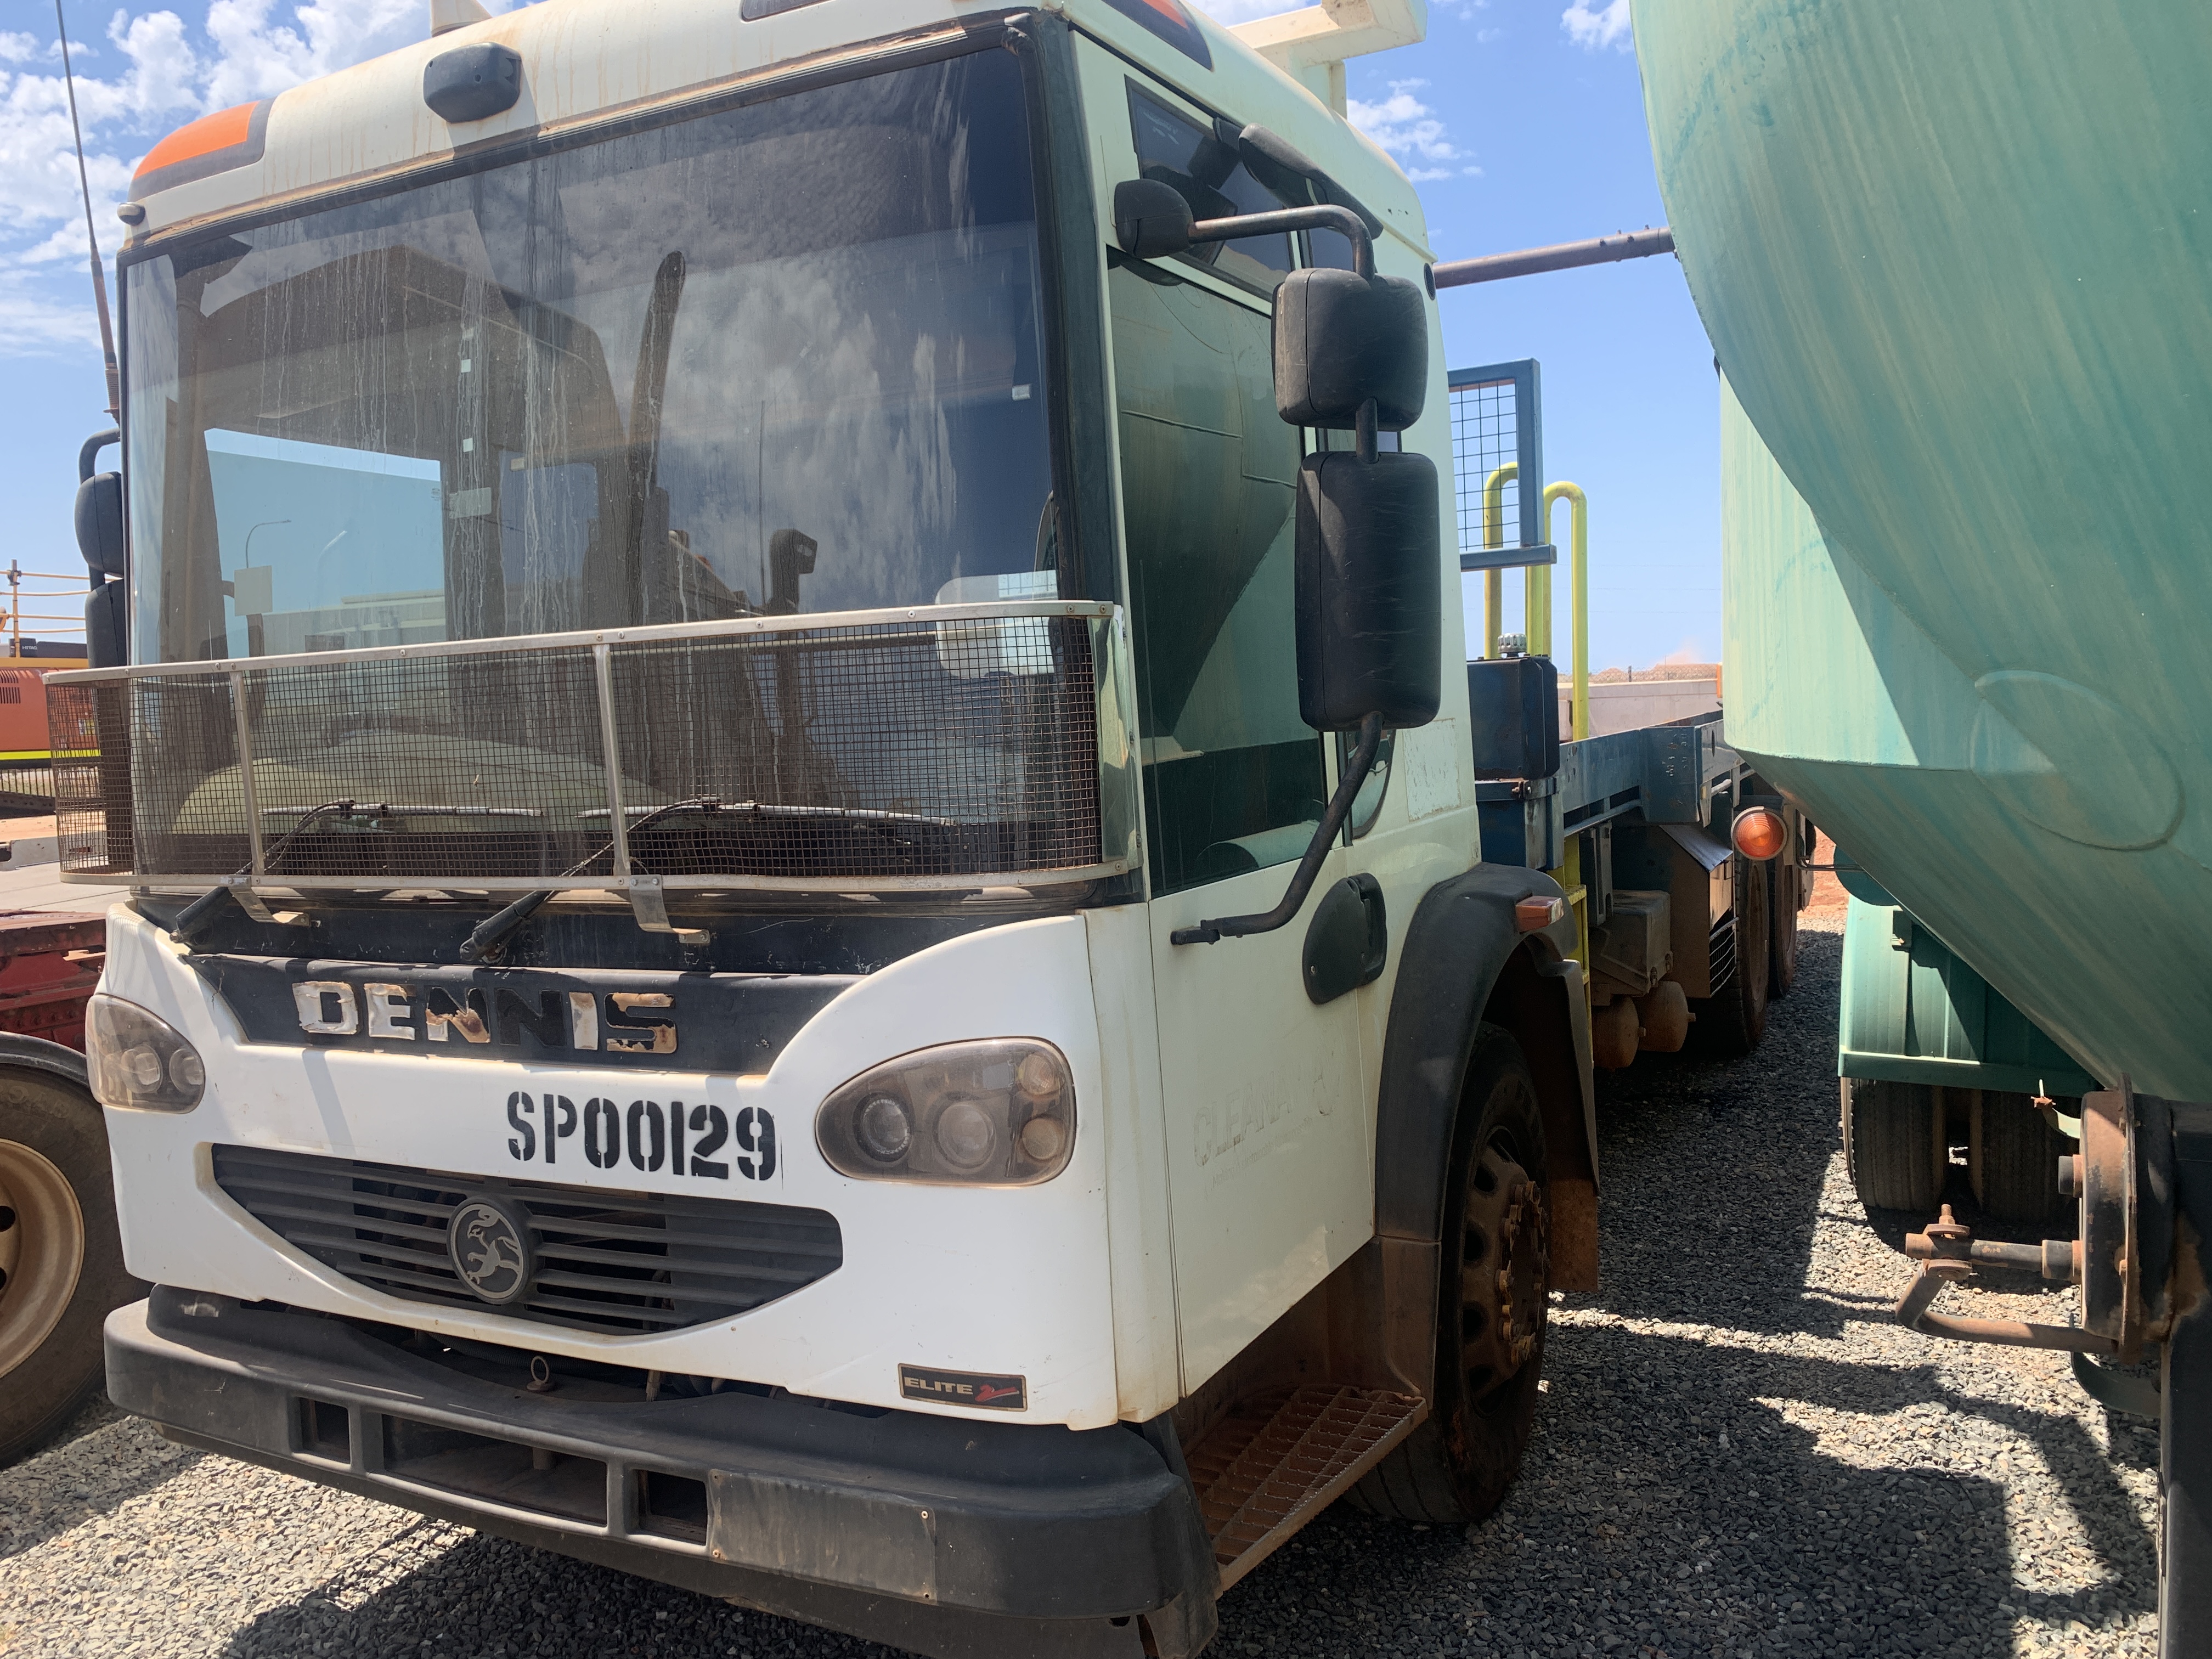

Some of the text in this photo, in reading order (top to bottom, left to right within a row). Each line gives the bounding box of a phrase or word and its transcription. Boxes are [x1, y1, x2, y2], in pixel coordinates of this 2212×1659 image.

[291, 980, 678, 1054] DENNIS
[507, 1091, 776, 1181] SP00129
[904, 1377, 973, 1395] ELITE
